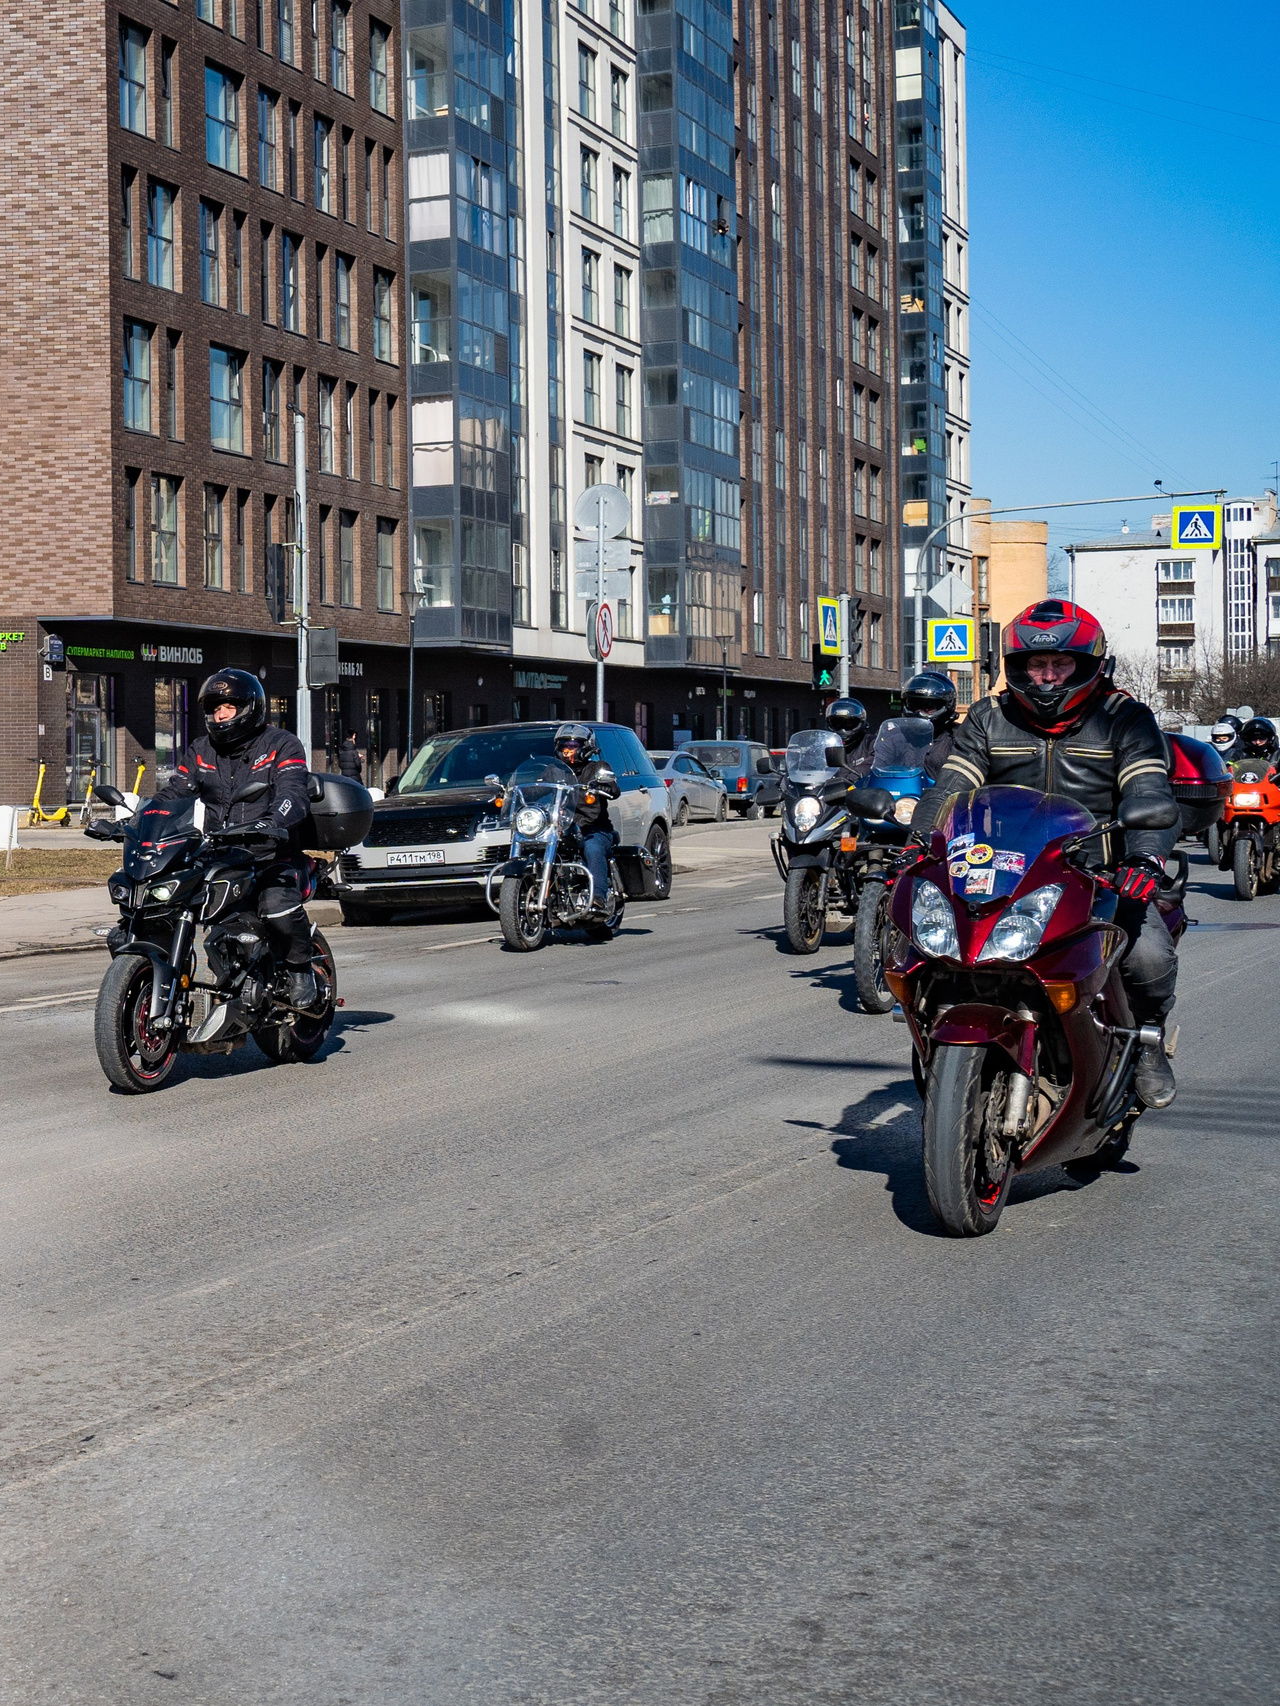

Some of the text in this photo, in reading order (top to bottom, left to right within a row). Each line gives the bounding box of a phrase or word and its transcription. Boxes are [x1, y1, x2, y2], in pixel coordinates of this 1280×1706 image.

[66, 646, 105, 658] СУПЕРМАРКЕТ
[105, 649, 135, 660] НАПИТКОВ
[338, 662, 355, 675] ЕБАБ
